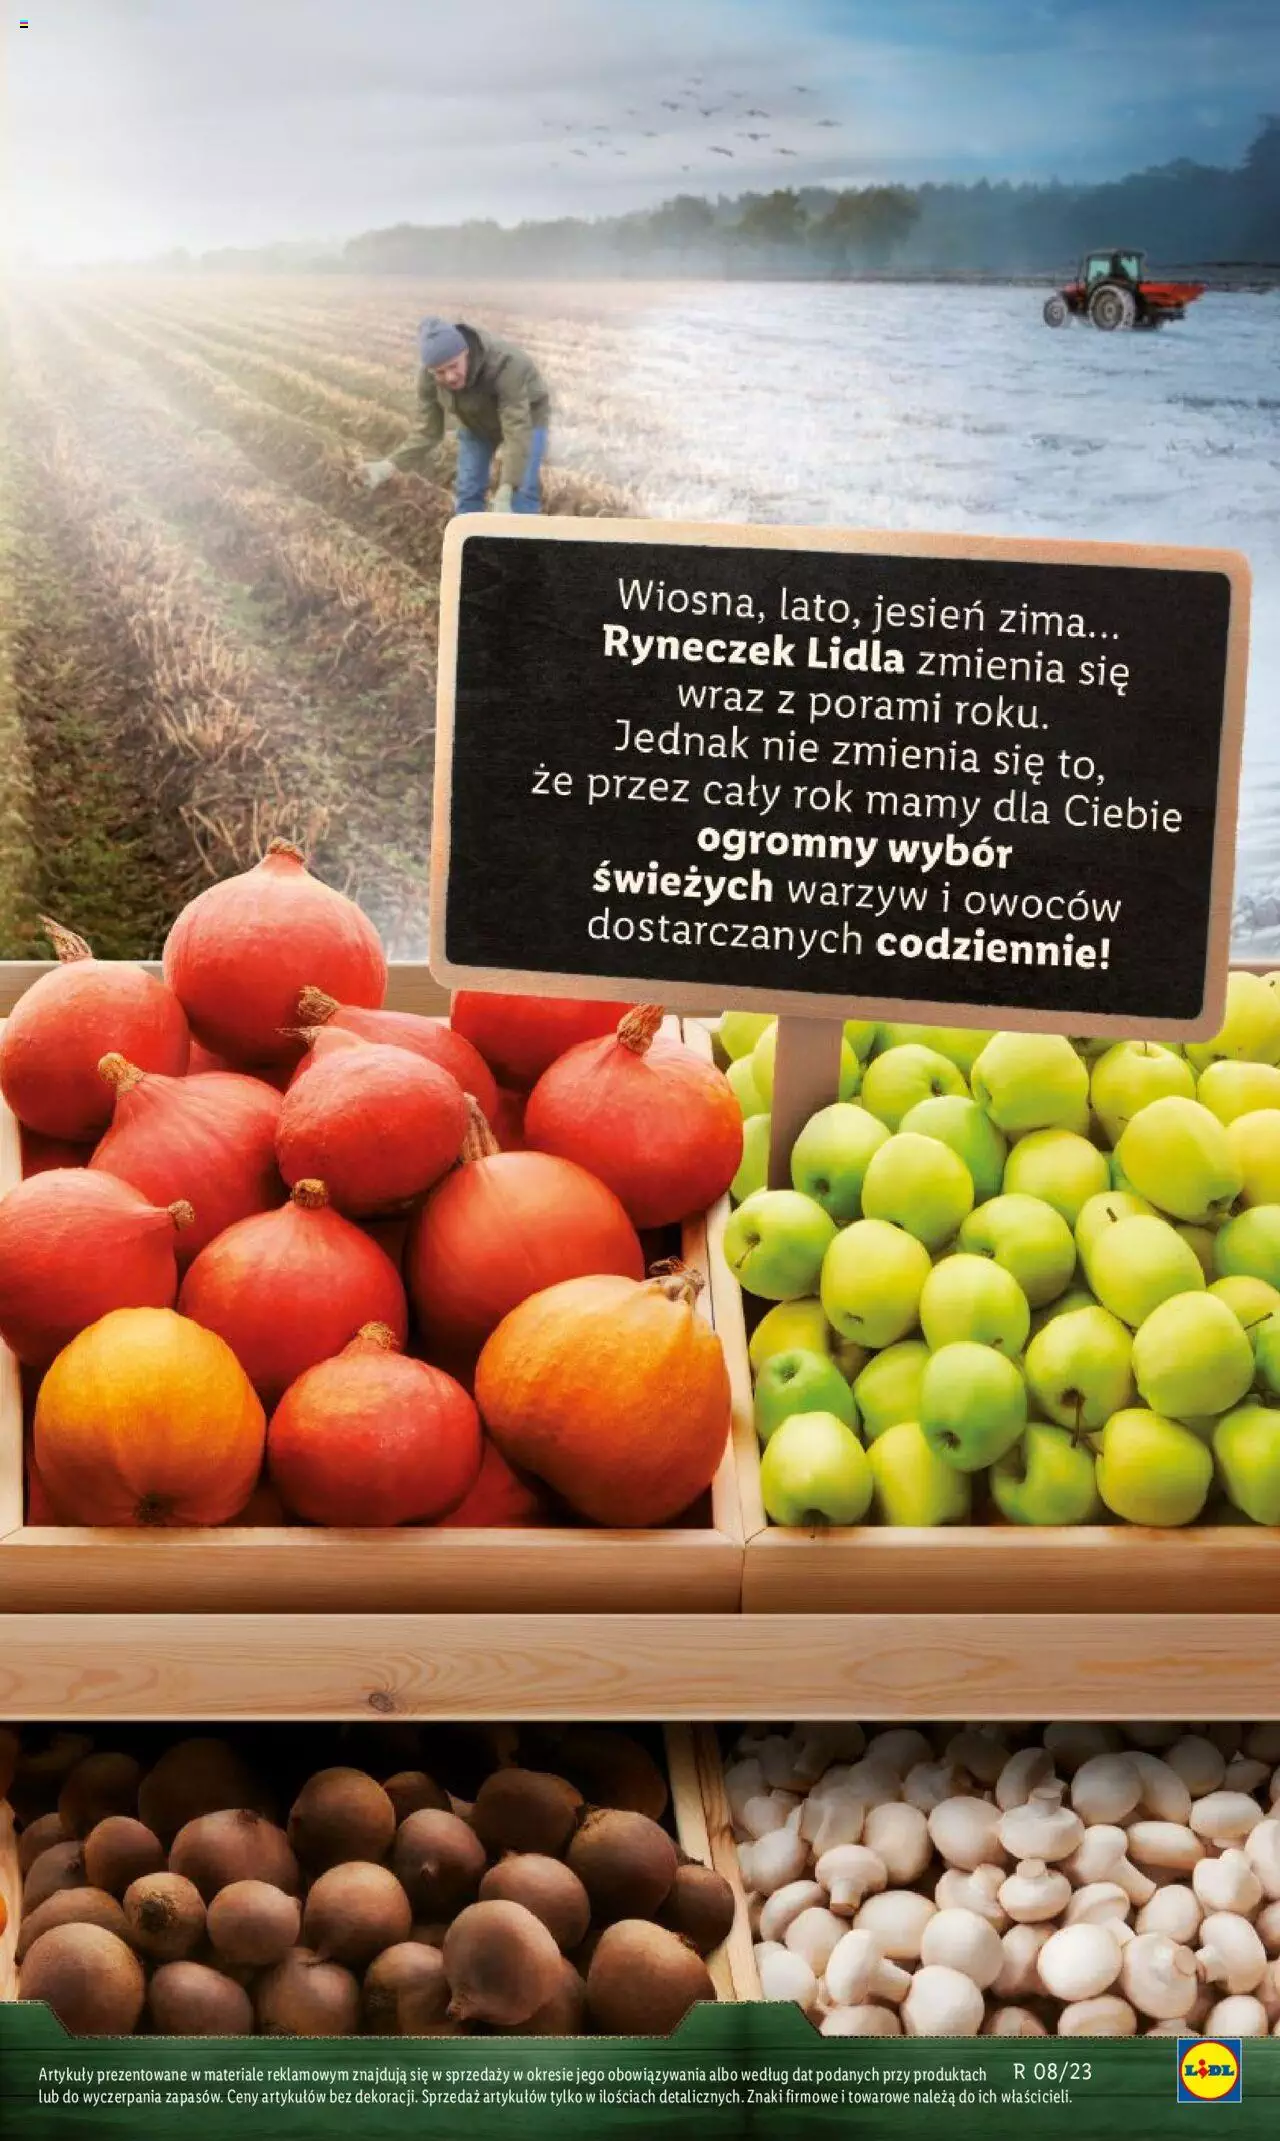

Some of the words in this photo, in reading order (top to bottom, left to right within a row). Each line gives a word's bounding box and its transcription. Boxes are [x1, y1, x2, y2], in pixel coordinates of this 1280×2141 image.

[618, 577, 766, 624] Wiosna,
[780, 586, 861, 630] lato,
[871, 594, 984, 635] jesień
[998, 602, 1119, 640] zima...
[603, 623, 796, 667] Ryneczek
[807, 635, 905, 675] Lidla
[916, 647, 1066, 684] zmienia
[1078, 654, 1130, 697] się
[678, 684, 764, 712] wraz
[777, 690, 795, 714] z
[809, 692, 941, 724] porami
[955, 694, 1048, 730] roku.
[614, 718, 749, 760] Jednak
[762, 729, 820, 763] nie
[832, 737, 981, 773] zmienia
[993, 743, 1045, 786] się
[1057, 749, 1105, 786] to,
[531, 762, 573, 796] że
[587, 773, 690, 806] przez
[703, 774, 781, 816] cały
[793, 779, 854, 813] rok
[866, 791, 981, 828] mamy
[993, 788, 1051, 825] dla
[1064, 794, 1182, 833] Ciebie
[697, 826, 879, 868] ogromny
[888, 833, 1013, 874] wybór
[592, 859, 773, 907] świeżych
[787, 880, 928, 918] warzyw
[942, 881, 951, 913] i
[964, 889, 1122, 923] owoców
[587, 906, 862, 960] dostarczanych
[875, 926, 1110, 966] codziennie!
